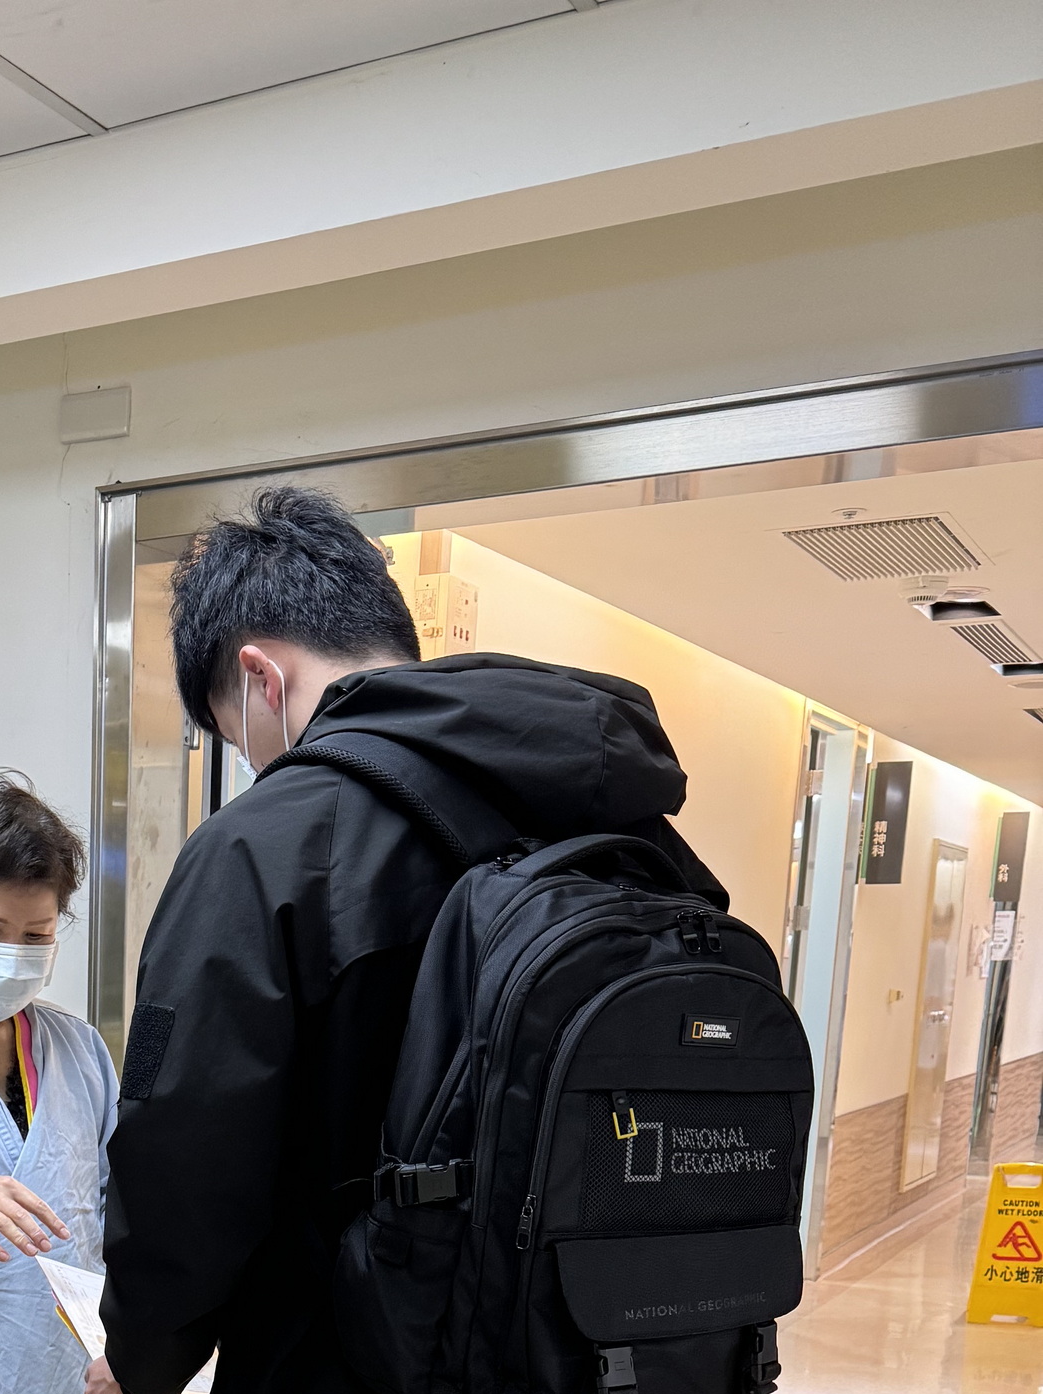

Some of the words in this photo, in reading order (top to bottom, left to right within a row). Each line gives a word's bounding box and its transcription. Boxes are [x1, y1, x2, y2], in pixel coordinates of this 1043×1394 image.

[702, 1030, 732, 1040] GEOGRAPHIC
[703, 1023, 727, 1032] NATIONAL
[671, 1126, 750, 1149] NATIONAL
[671, 1148, 777, 1174] GEOGRAPHIC
[1003, 1199, 1040, 1208] CAUTION
[997, 1208, 1015, 1216] WET
[984, 1265, 1043, 1285] 小心地滑
[624, 1304, 695, 1320] NATIONAL
[697, 1291, 767, 1312] GEOGRAPHIC
